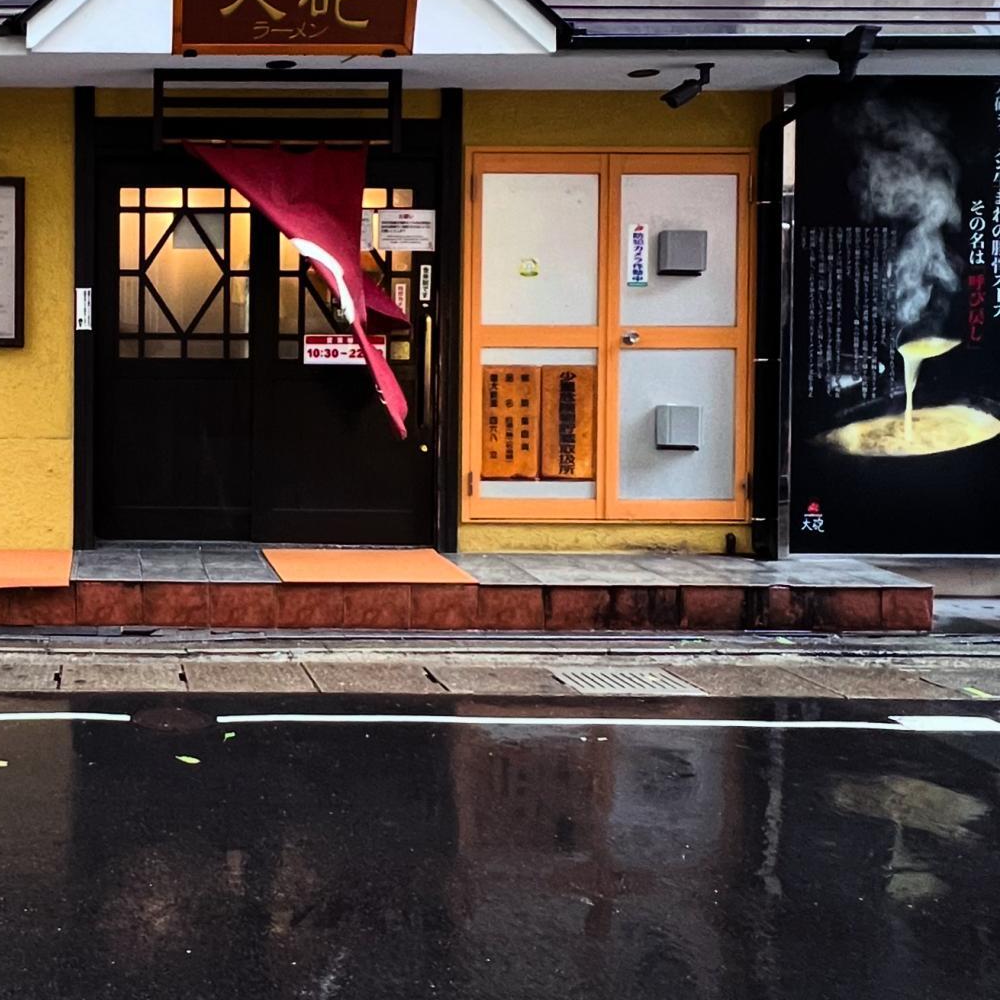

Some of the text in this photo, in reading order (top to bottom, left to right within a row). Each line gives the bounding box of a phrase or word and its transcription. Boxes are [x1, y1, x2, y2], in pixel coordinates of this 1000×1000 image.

[253, 21, 329, 39] ラーメン
[800, 517, 825, 533] 大砲
